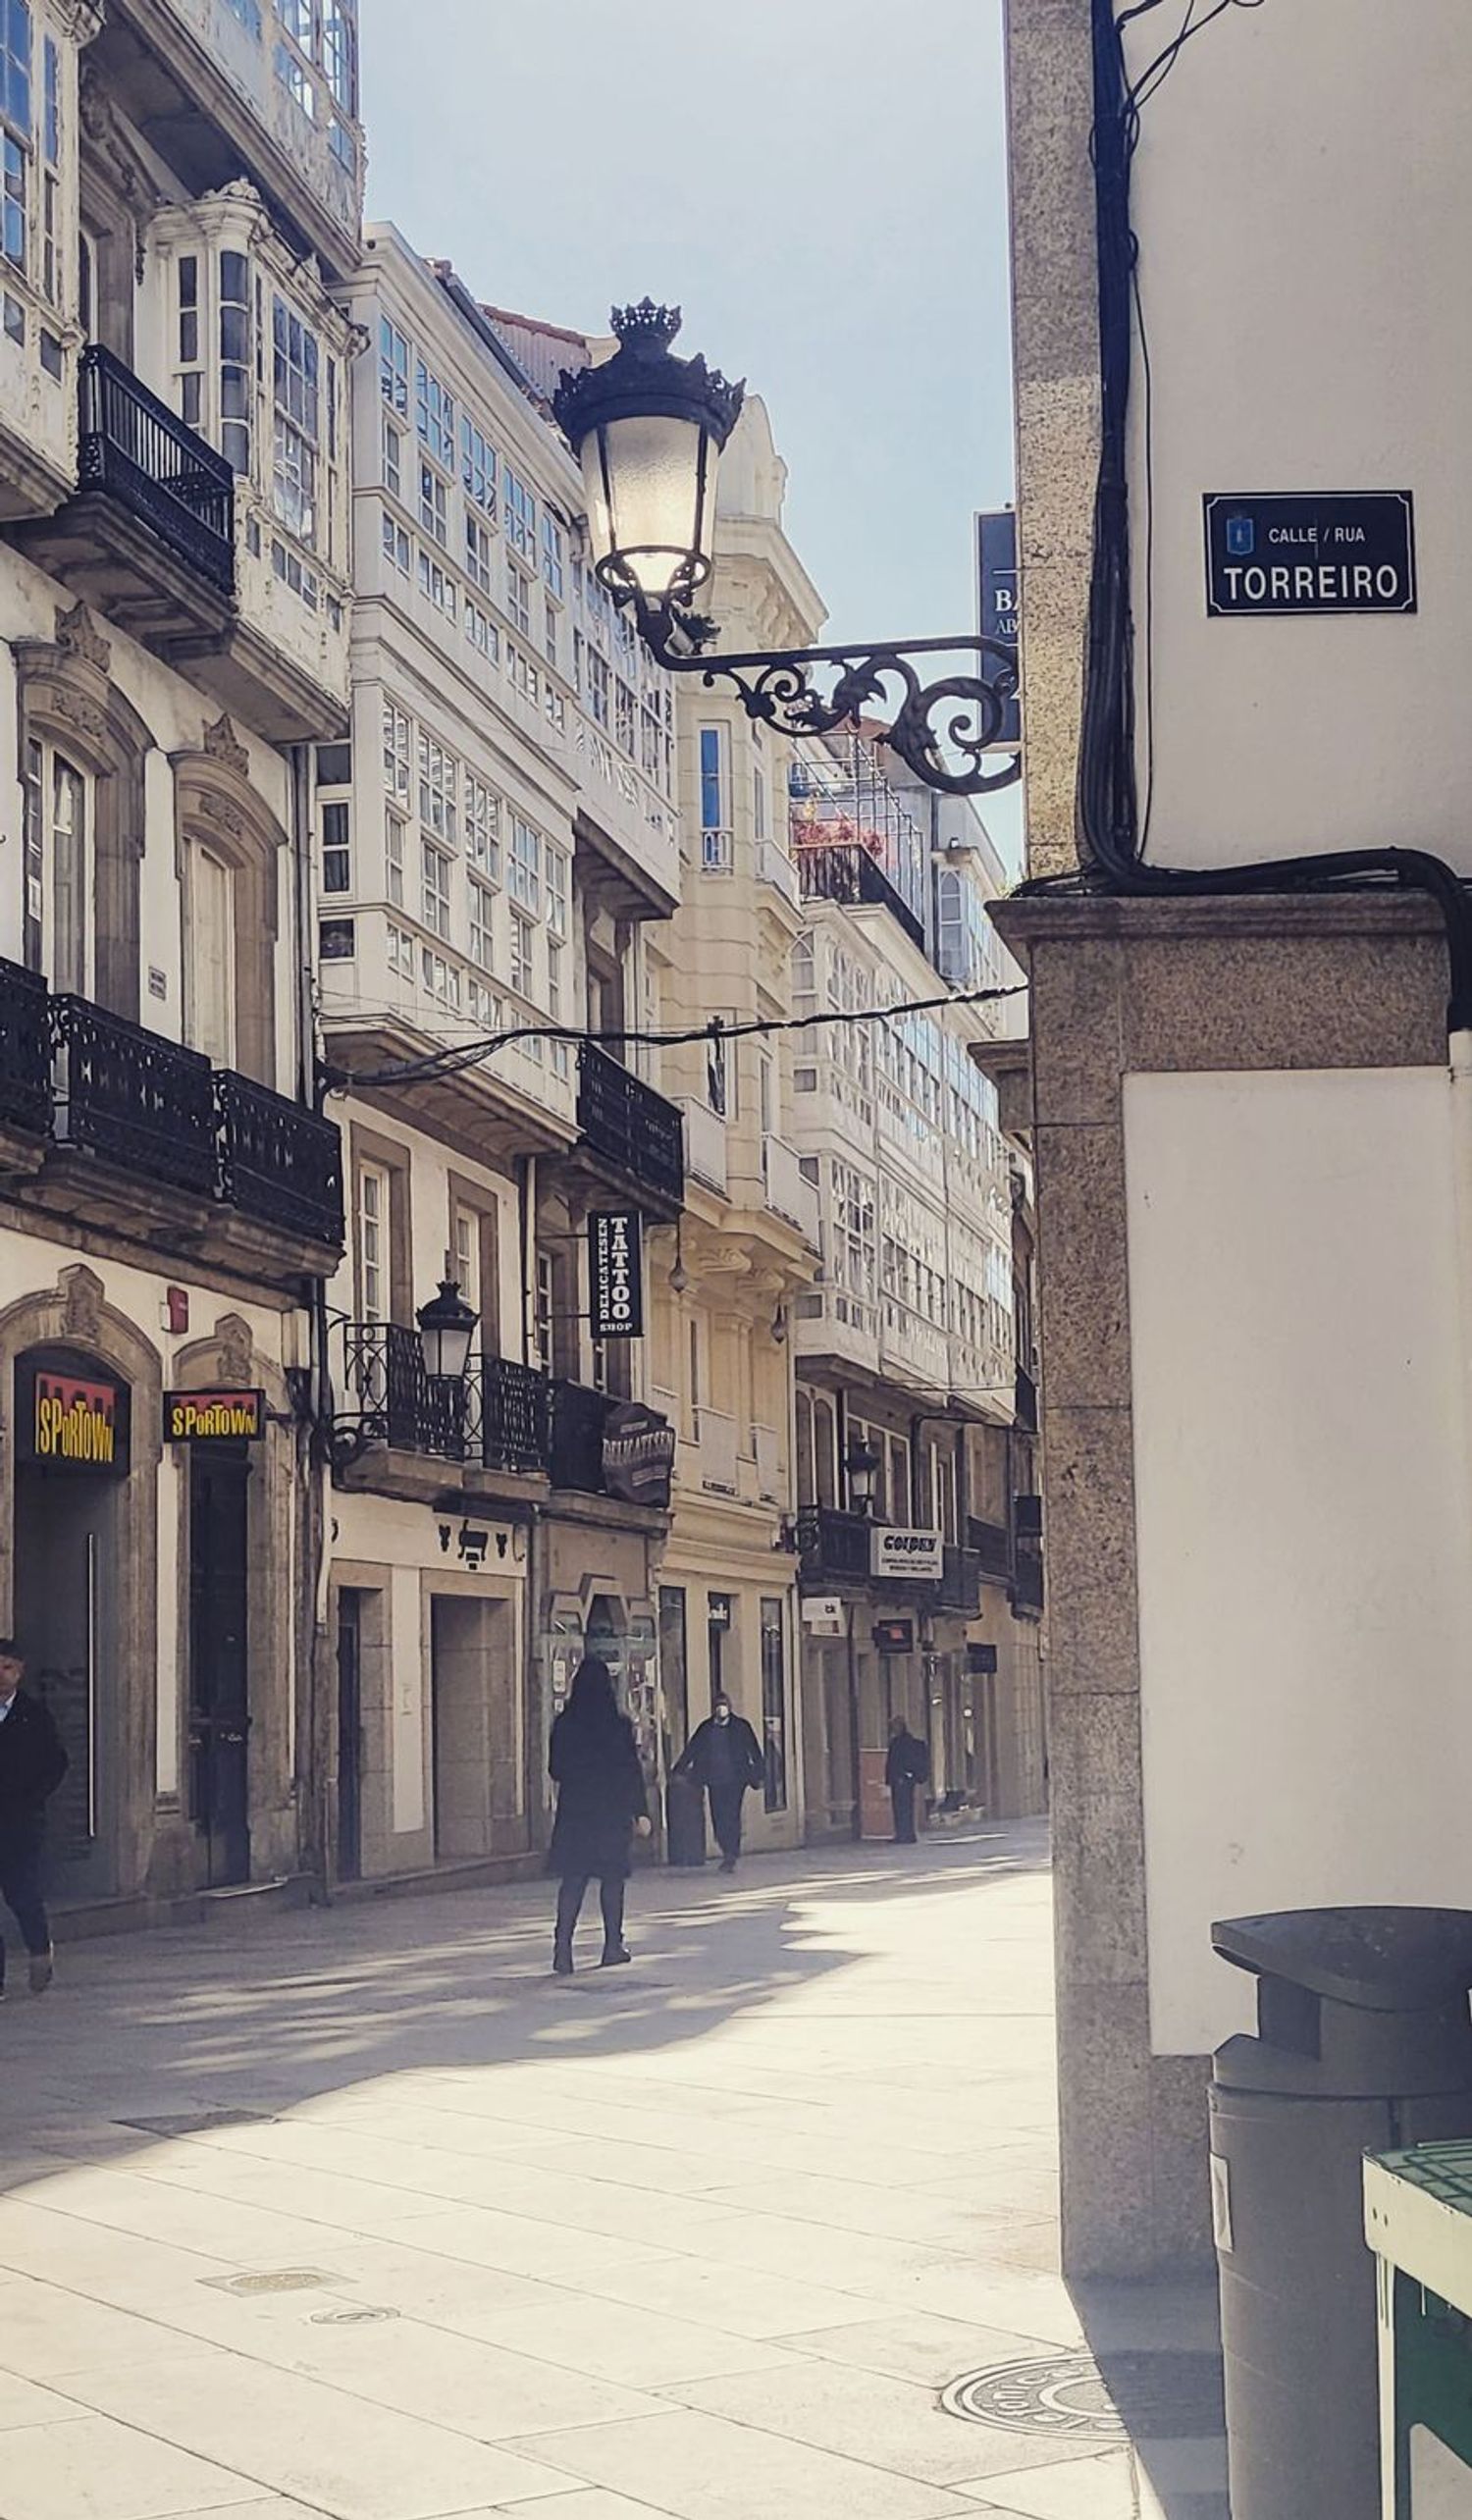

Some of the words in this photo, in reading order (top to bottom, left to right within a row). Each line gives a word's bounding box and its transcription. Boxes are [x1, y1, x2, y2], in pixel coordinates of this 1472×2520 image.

[1268, 527, 1317, 544] CALLE
[1335, 526, 1366, 543] RUA
[1223, 563, 1398, 601] TORREIRO
[994, 589, 1018, 612] B
[597, 1217, 609, 1321] DELICATESEN
[610, 1216, 631, 1320] TATTOO
[599, 1322, 634, 1333] SHOP
[39, 1397, 114, 1463] SPORTOWN
[172, 1404, 256, 1436] SPORTOWN
